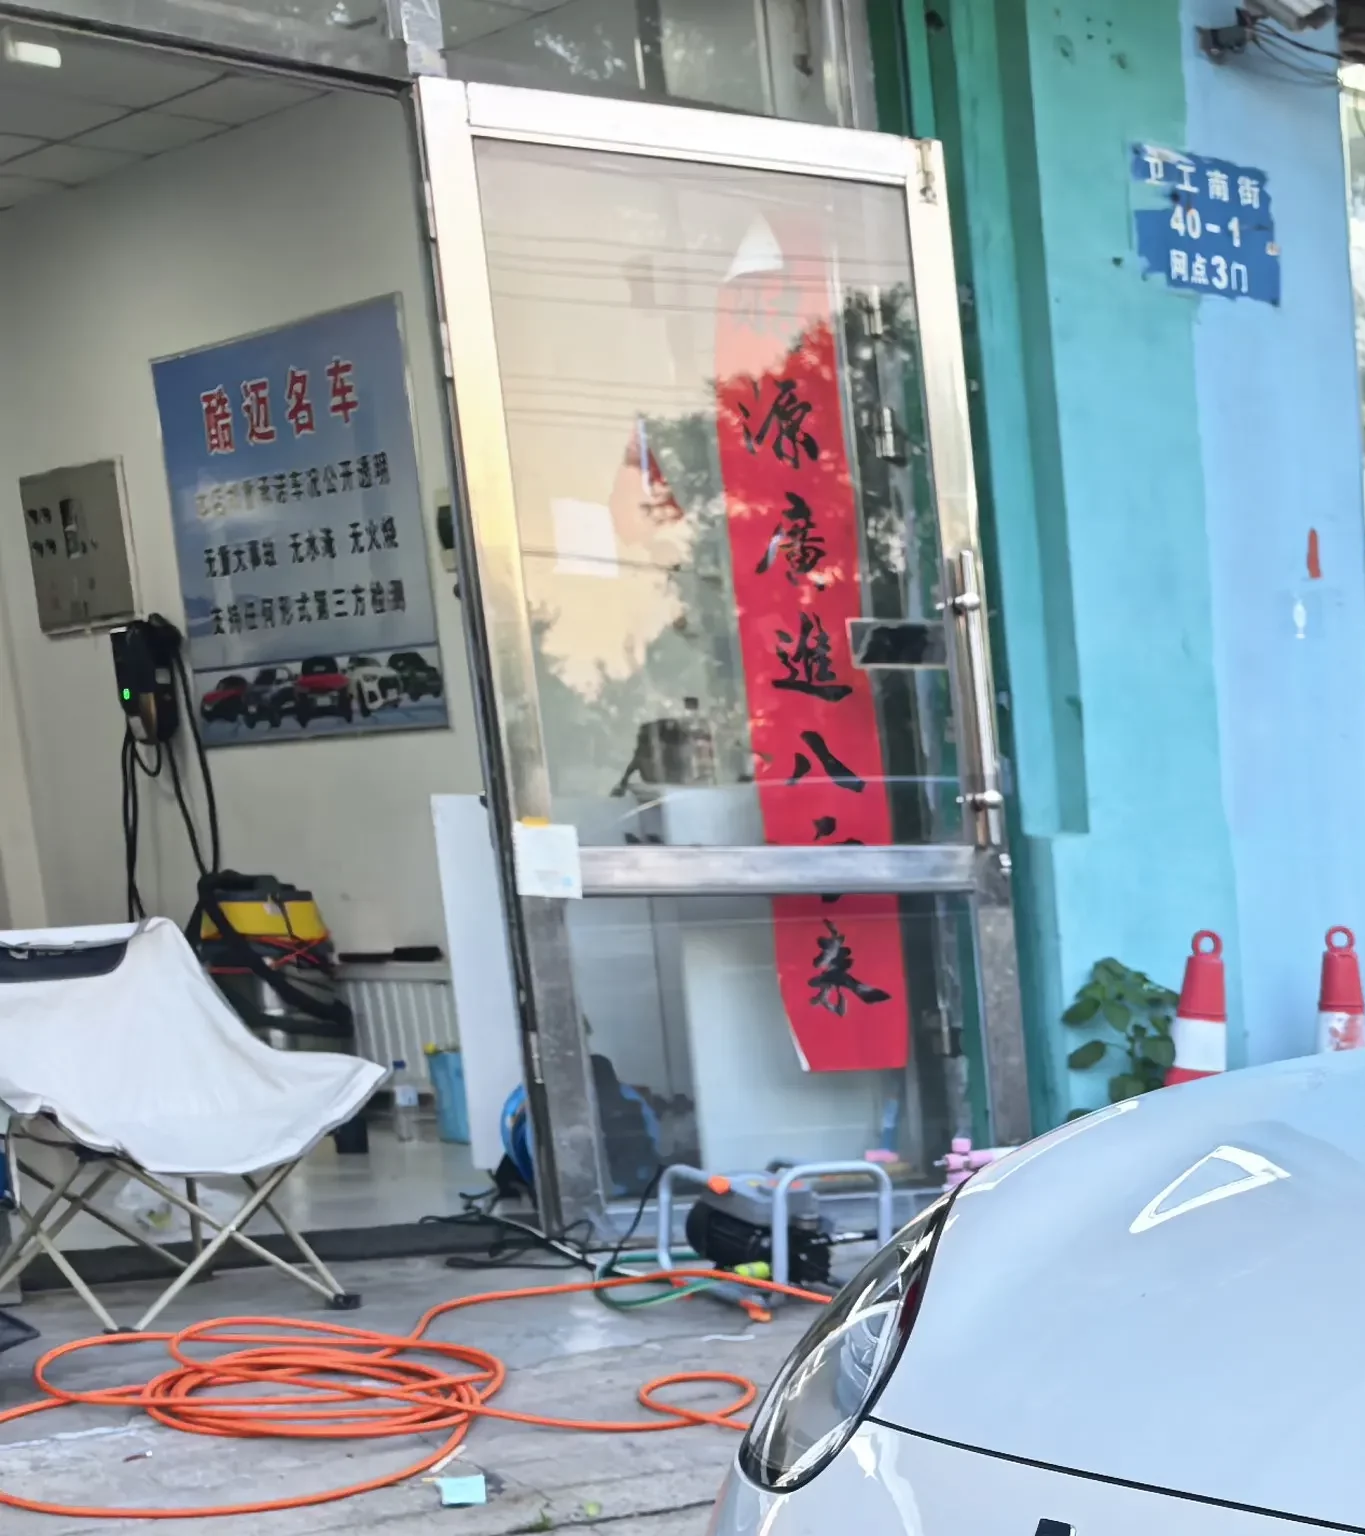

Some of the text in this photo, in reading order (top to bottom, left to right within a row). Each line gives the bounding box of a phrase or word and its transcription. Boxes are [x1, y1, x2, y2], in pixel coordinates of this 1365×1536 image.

[1170, 203, 1241, 248] 40-1
[201, 355, 358, 455] 酷迈名车
